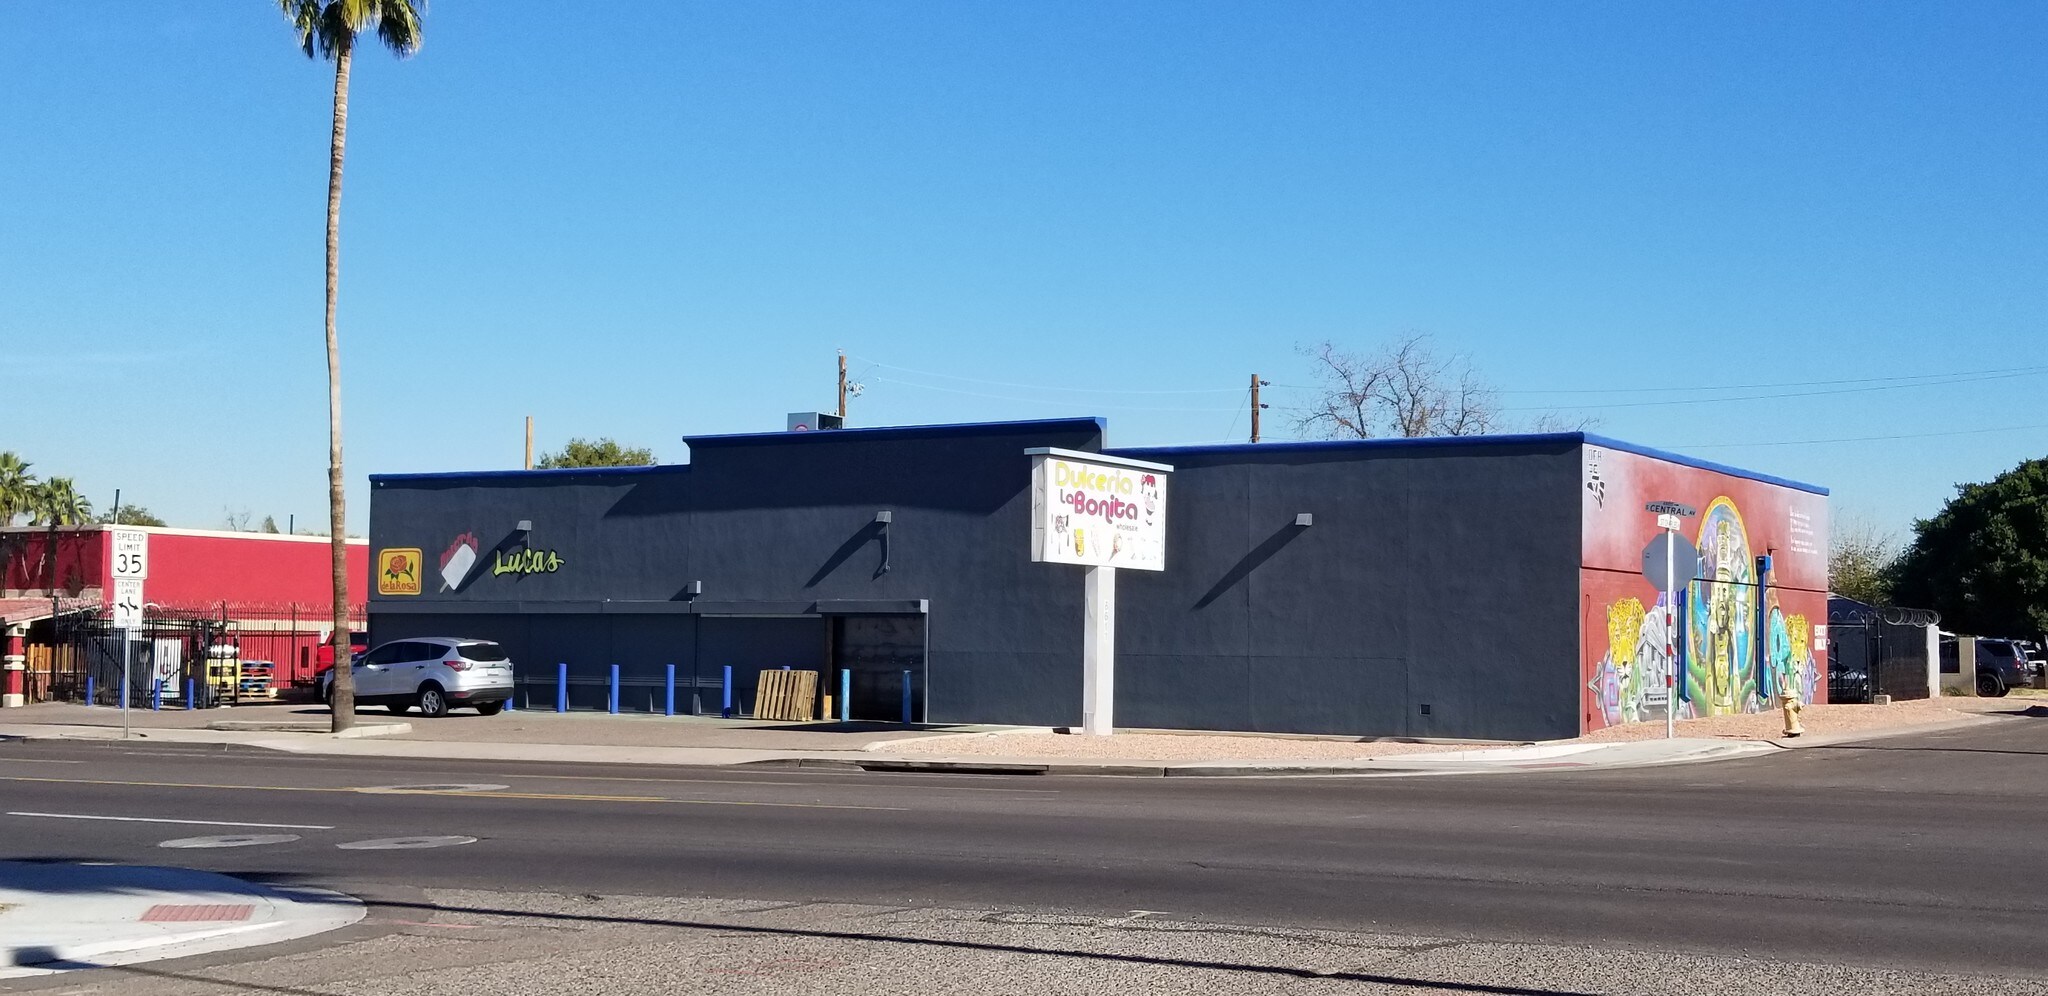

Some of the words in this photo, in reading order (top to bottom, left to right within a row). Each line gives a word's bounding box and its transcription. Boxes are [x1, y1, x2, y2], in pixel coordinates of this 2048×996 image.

[1074, 490, 1138, 524] Bonita
[1650, 504, 1687, 516] CENTRAL
[116, 532, 144, 542] SPEED
[118, 543, 141, 552] LIMIT
[117, 553, 142, 574] 35
[493, 548, 566, 577] Lucas
[117, 580, 141, 588] CENTER
